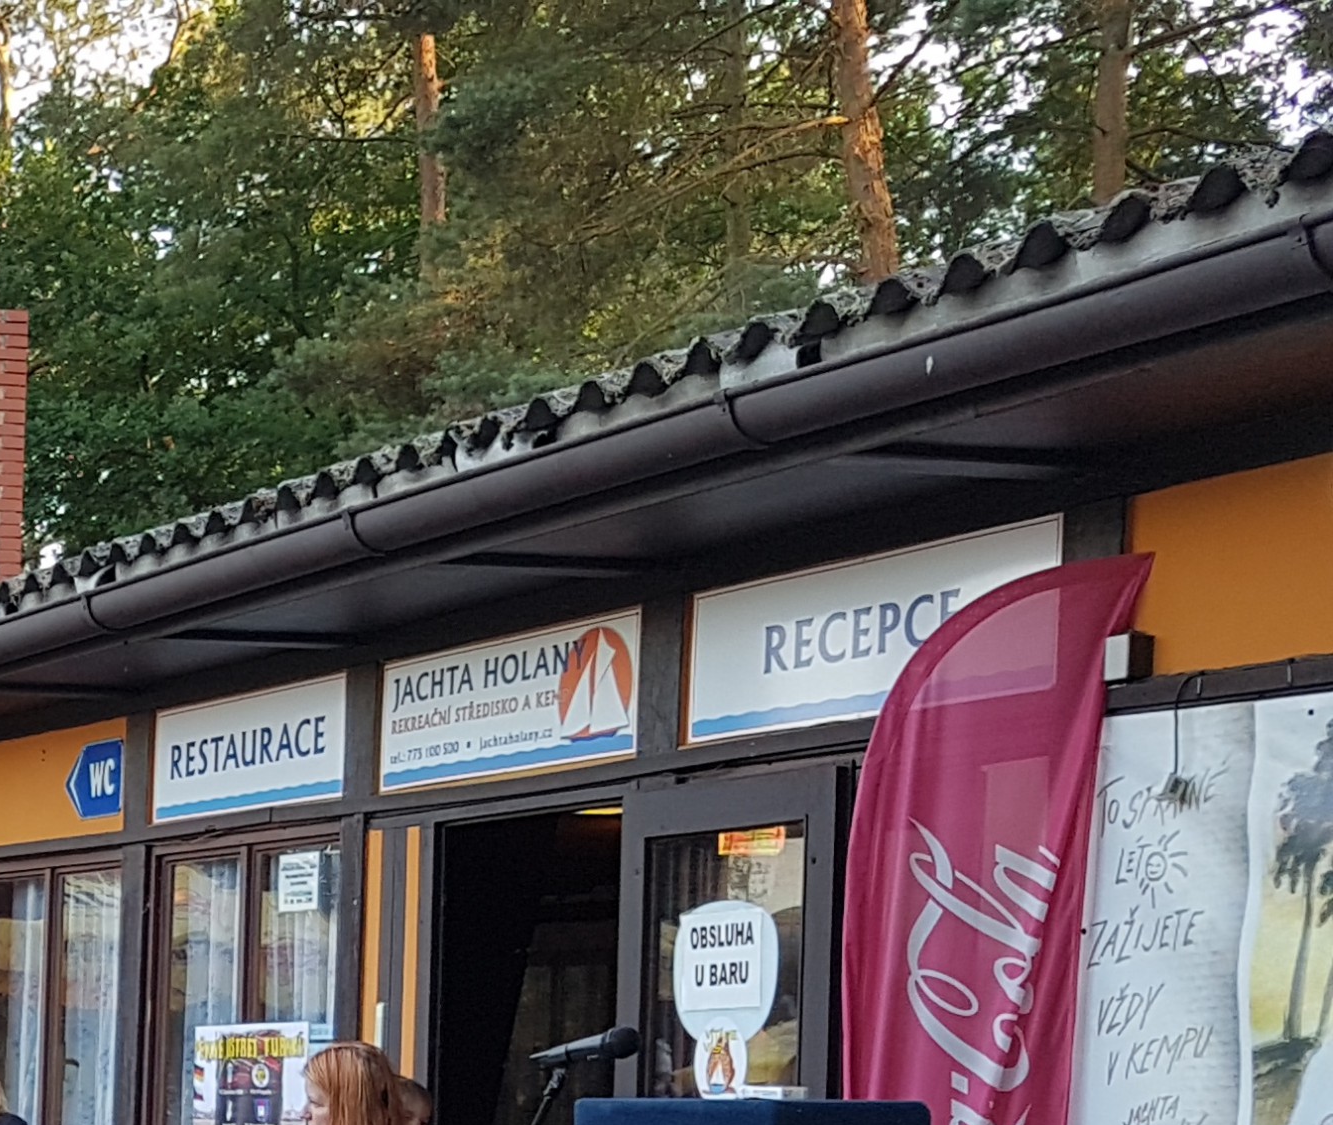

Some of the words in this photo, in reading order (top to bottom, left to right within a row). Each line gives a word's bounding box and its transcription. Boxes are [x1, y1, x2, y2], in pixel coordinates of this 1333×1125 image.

[762, 588, 961, 676] RECEPCE
[392, 663, 474, 713] JACHTA
[483, 638, 587, 690] HOLANY
[391, 704, 451, 735] REKREAČNÍ
[454, 696, 517, 723] STŘEDISKO
[522, 694, 532, 711] A
[169, 715, 327, 782] RESTAURACE
[89, 758, 115, 799] WC
[690, 921, 755, 950] OBSLUHA
[1087, 905, 1205, 971] ZAŽIJETE
[695, 964, 705, 987] U
[709, 960, 750, 987] BARU
[1097, 982, 1165, 1037] VŽDY
[1125, 1025, 1214, 1080] KEMPU
